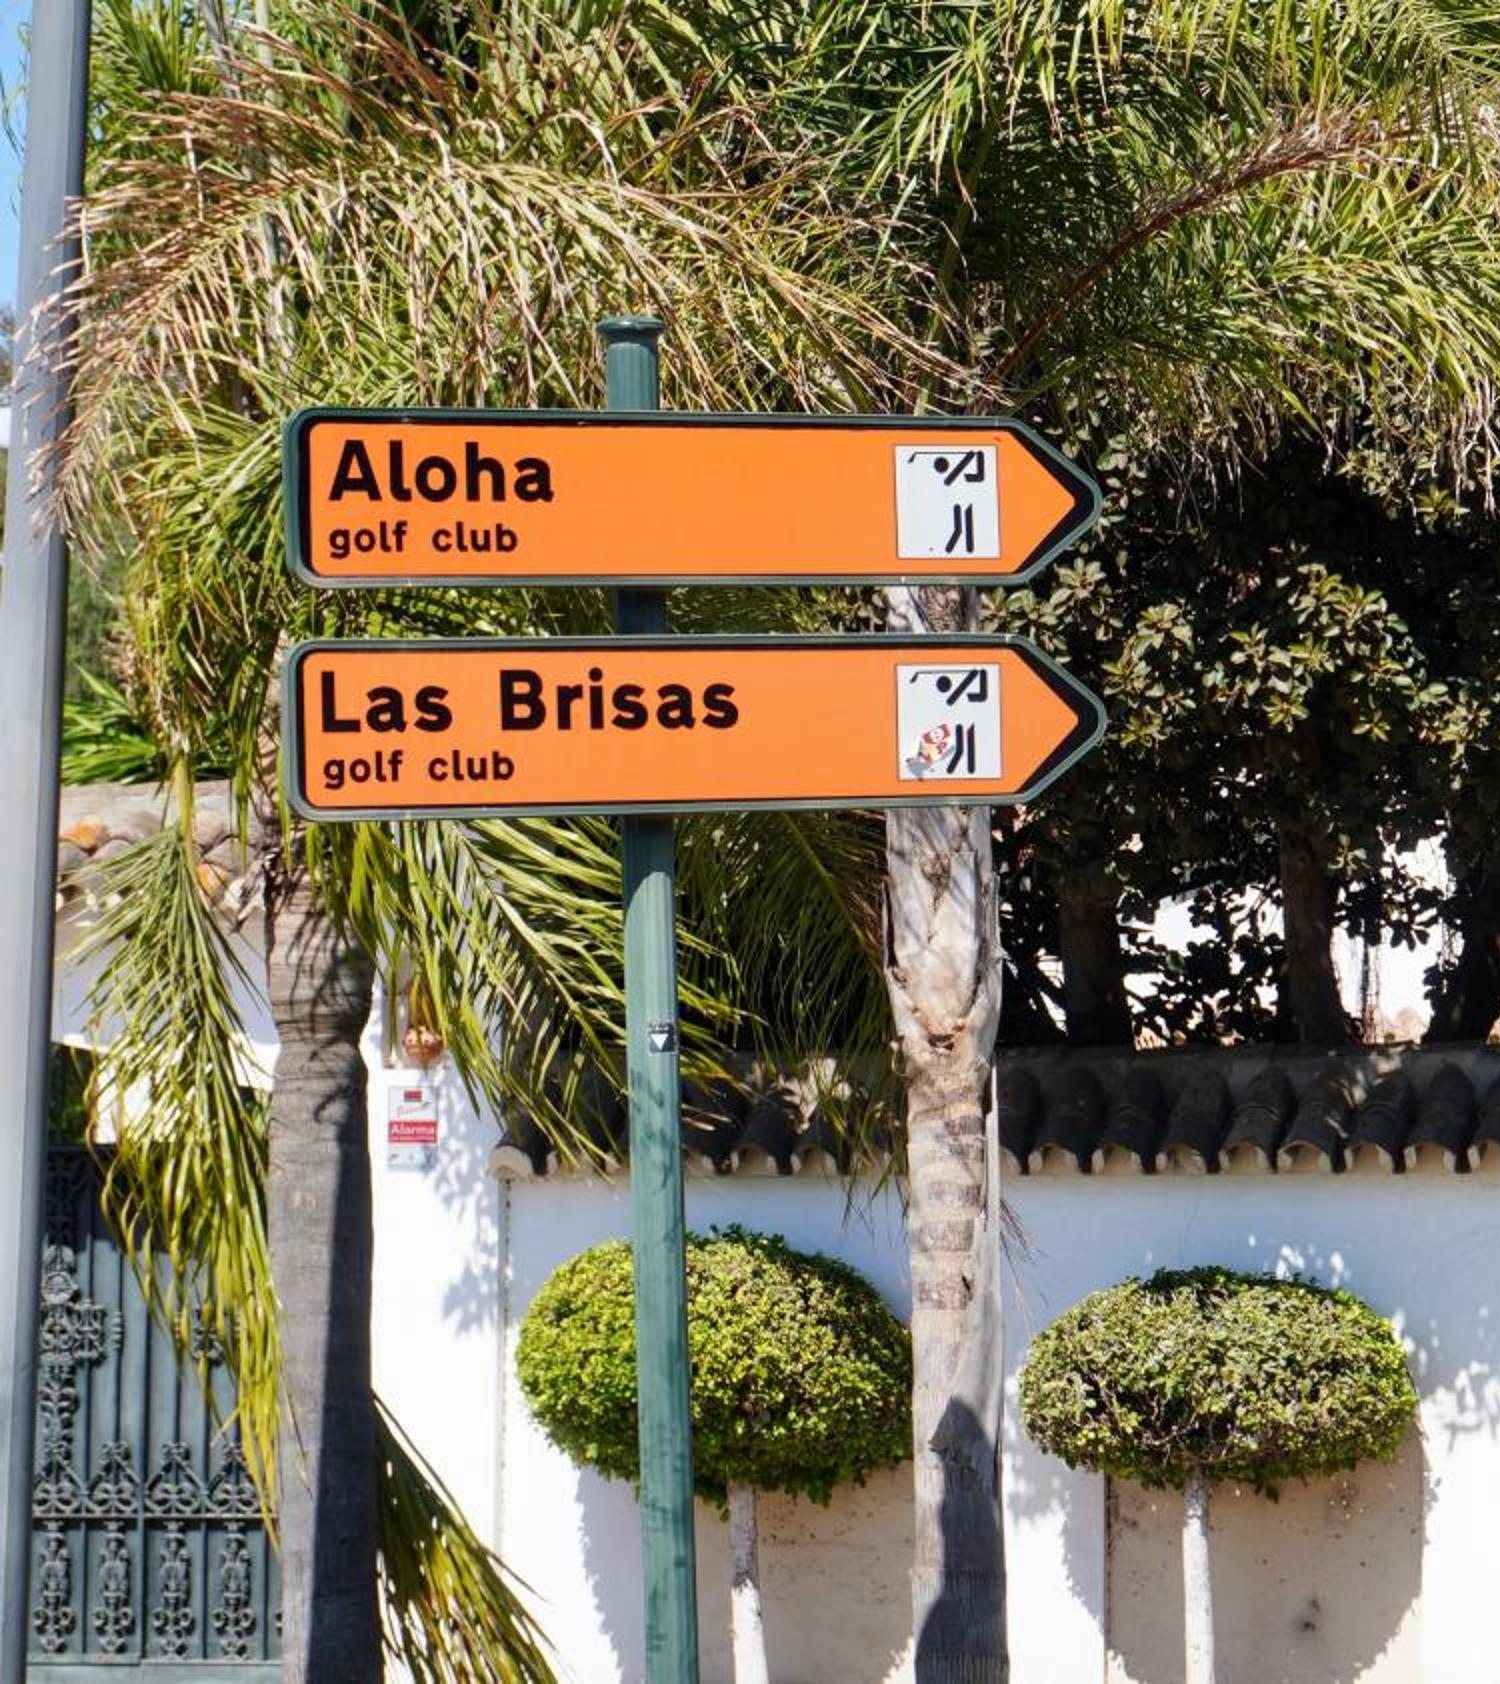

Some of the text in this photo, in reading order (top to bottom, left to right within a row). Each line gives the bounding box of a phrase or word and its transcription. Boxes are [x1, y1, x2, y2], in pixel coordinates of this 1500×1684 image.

[329, 439, 554, 503] Aloha
[329, 520, 518, 559] golf club
[321, 667, 739, 733] Las Brisas
[323, 750, 515, 789] golf club
